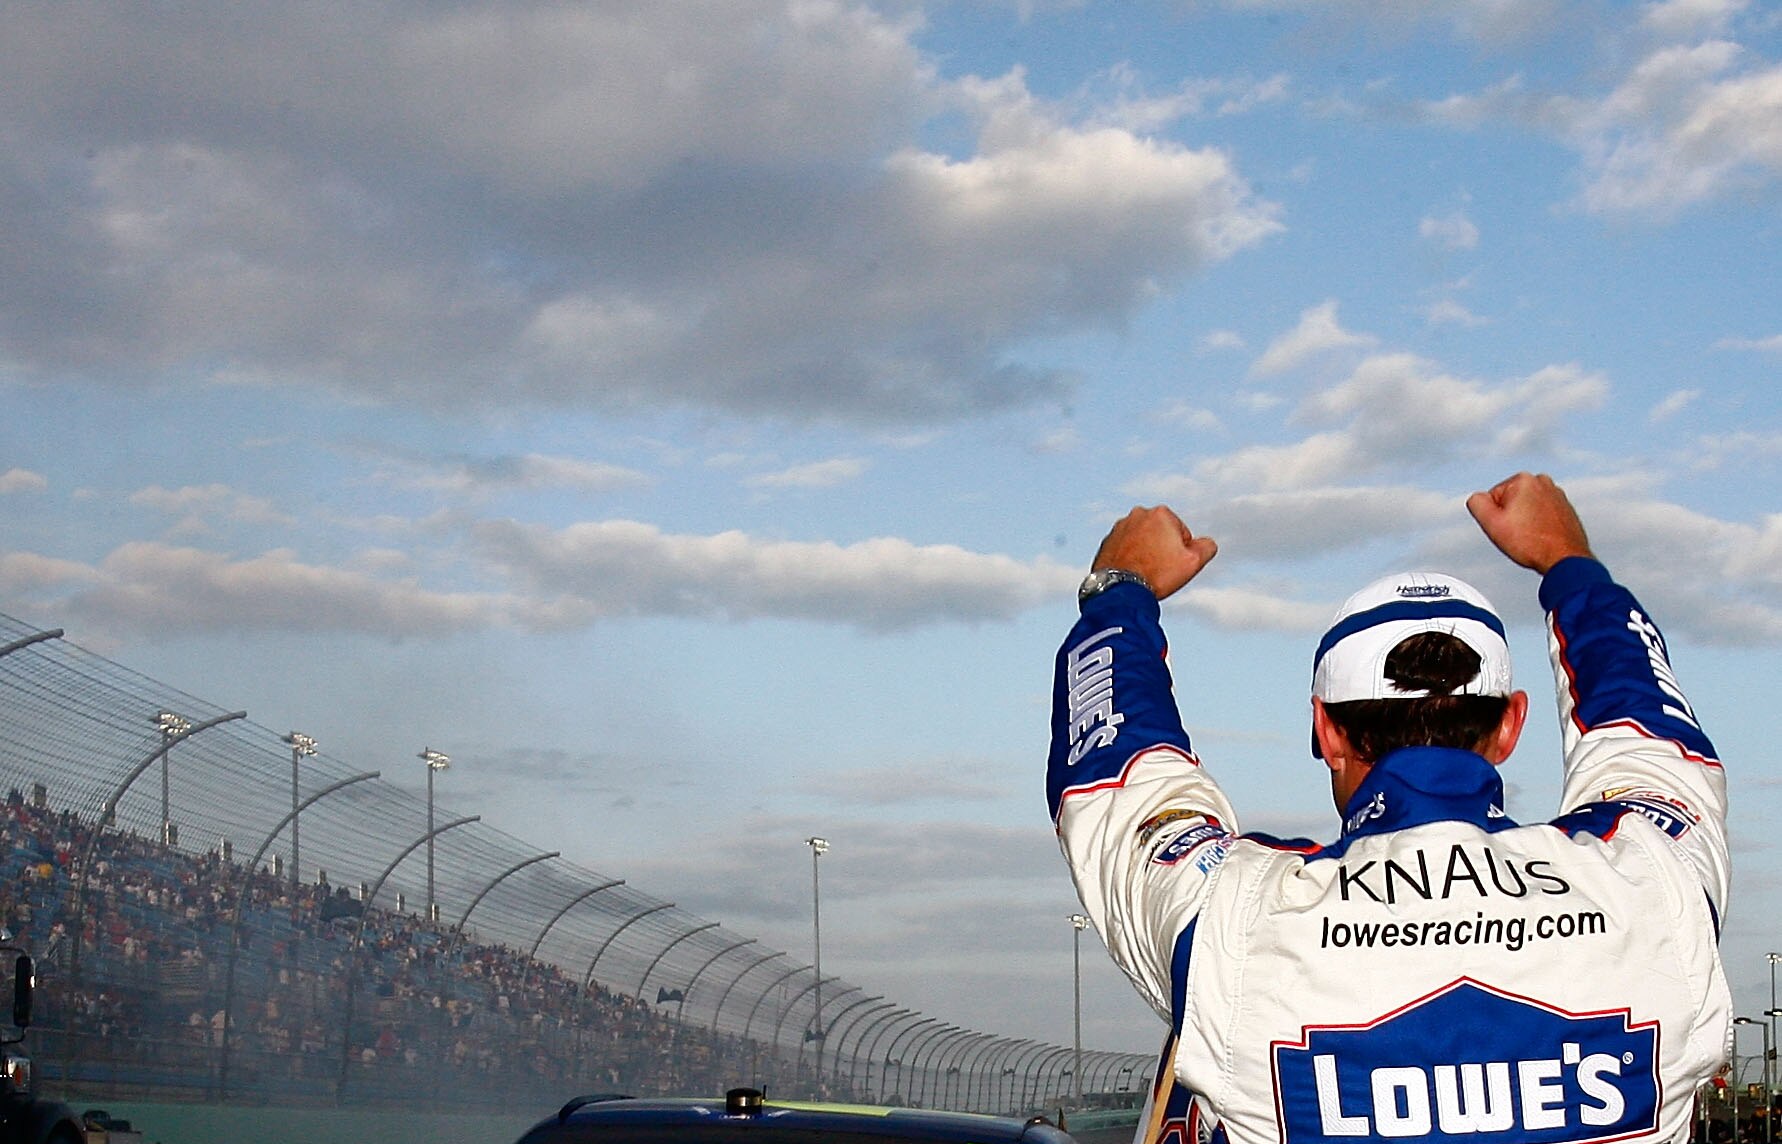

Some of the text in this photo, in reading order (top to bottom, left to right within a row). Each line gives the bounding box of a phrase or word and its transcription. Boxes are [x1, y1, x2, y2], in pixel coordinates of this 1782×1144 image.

[1338, 844, 1571, 905] KNAUS
[1321, 911, 1607, 951] lowesracing.com
[1313, 1043, 1625, 1138] LOWE'S
